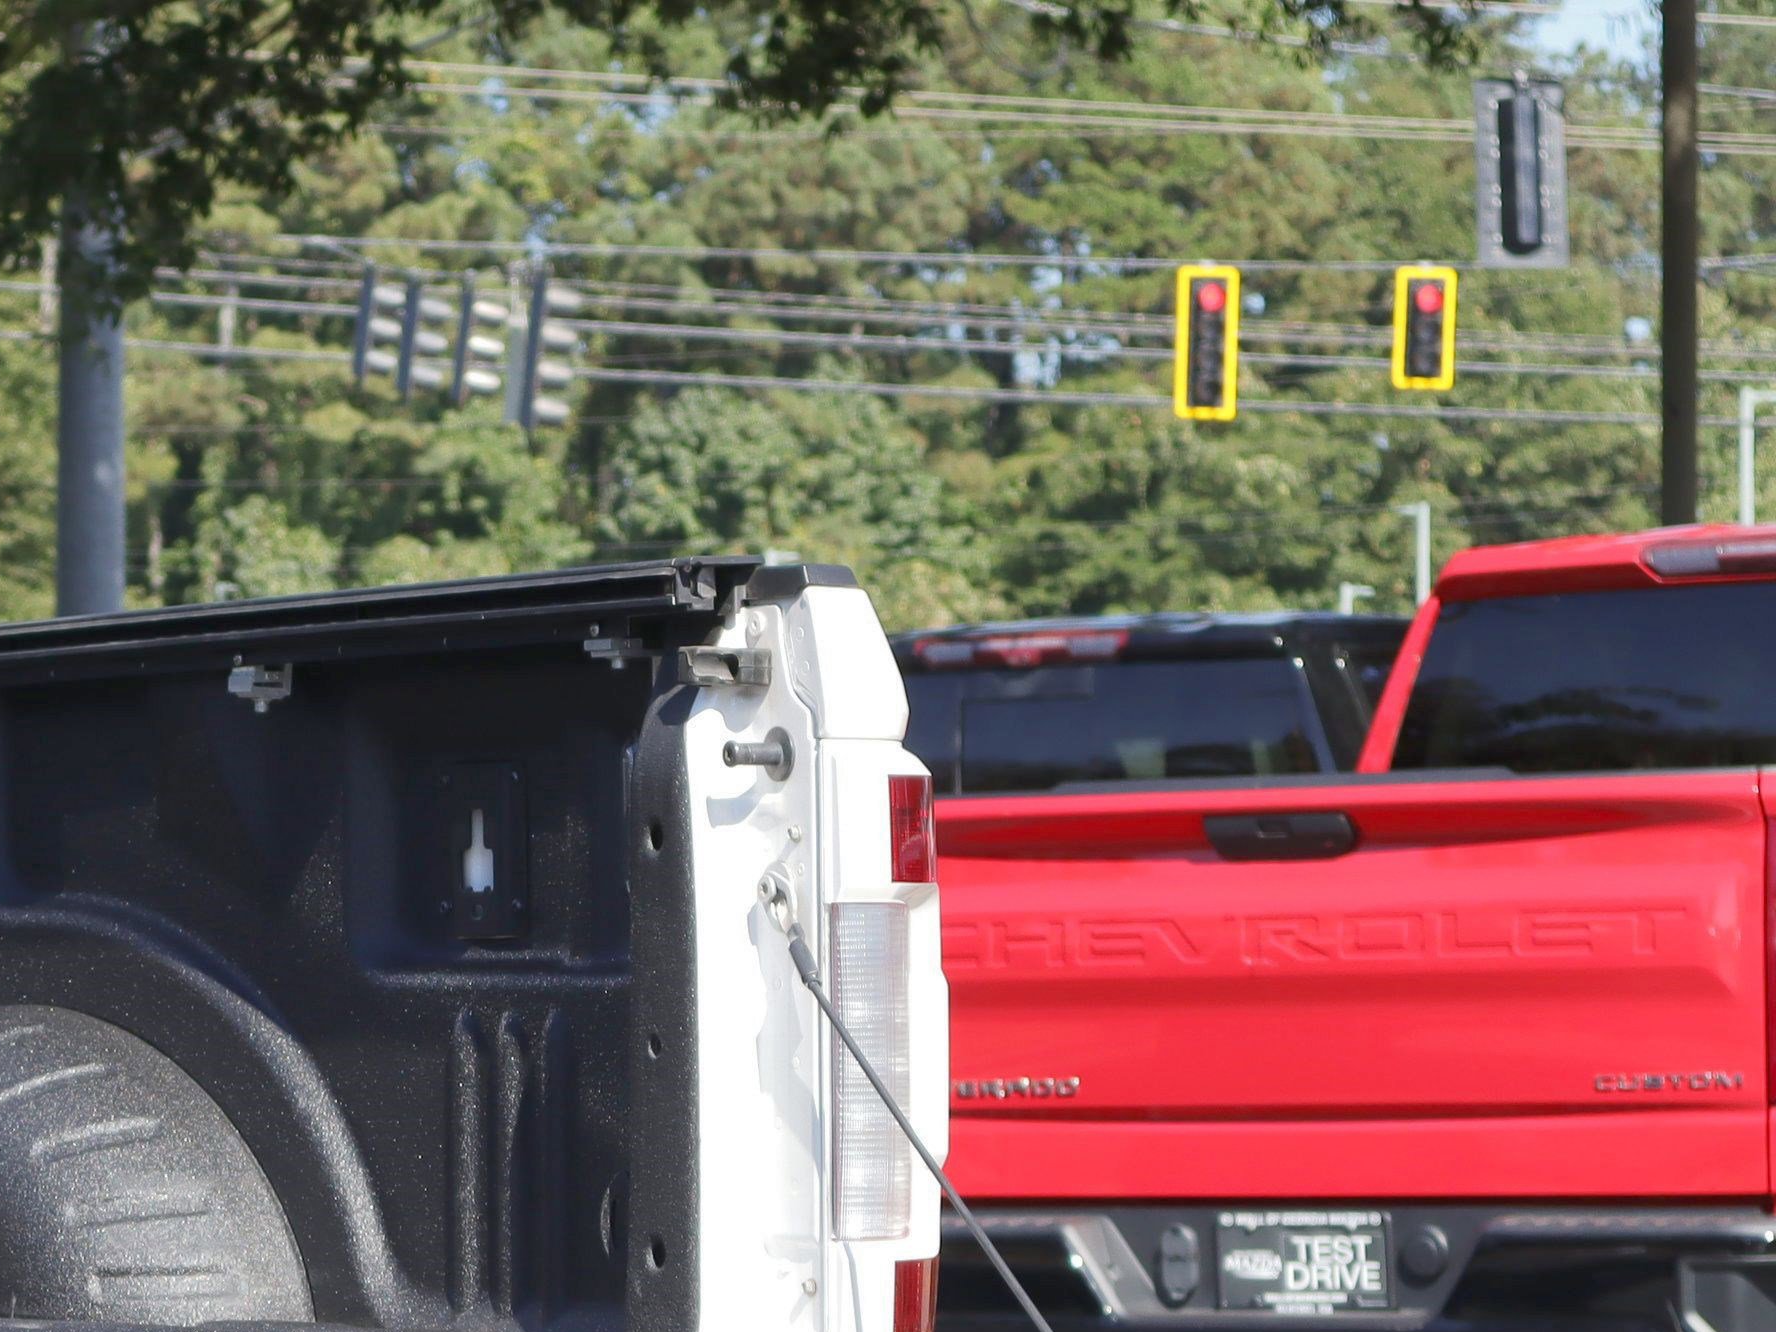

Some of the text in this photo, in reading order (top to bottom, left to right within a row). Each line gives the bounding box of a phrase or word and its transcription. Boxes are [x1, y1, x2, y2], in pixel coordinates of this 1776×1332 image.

[1594, 1071, 1744, 1091] CUSTOM
[1290, 1234, 1373, 1264] TEST
[1285, 1260, 1382, 1291] DRIVE
